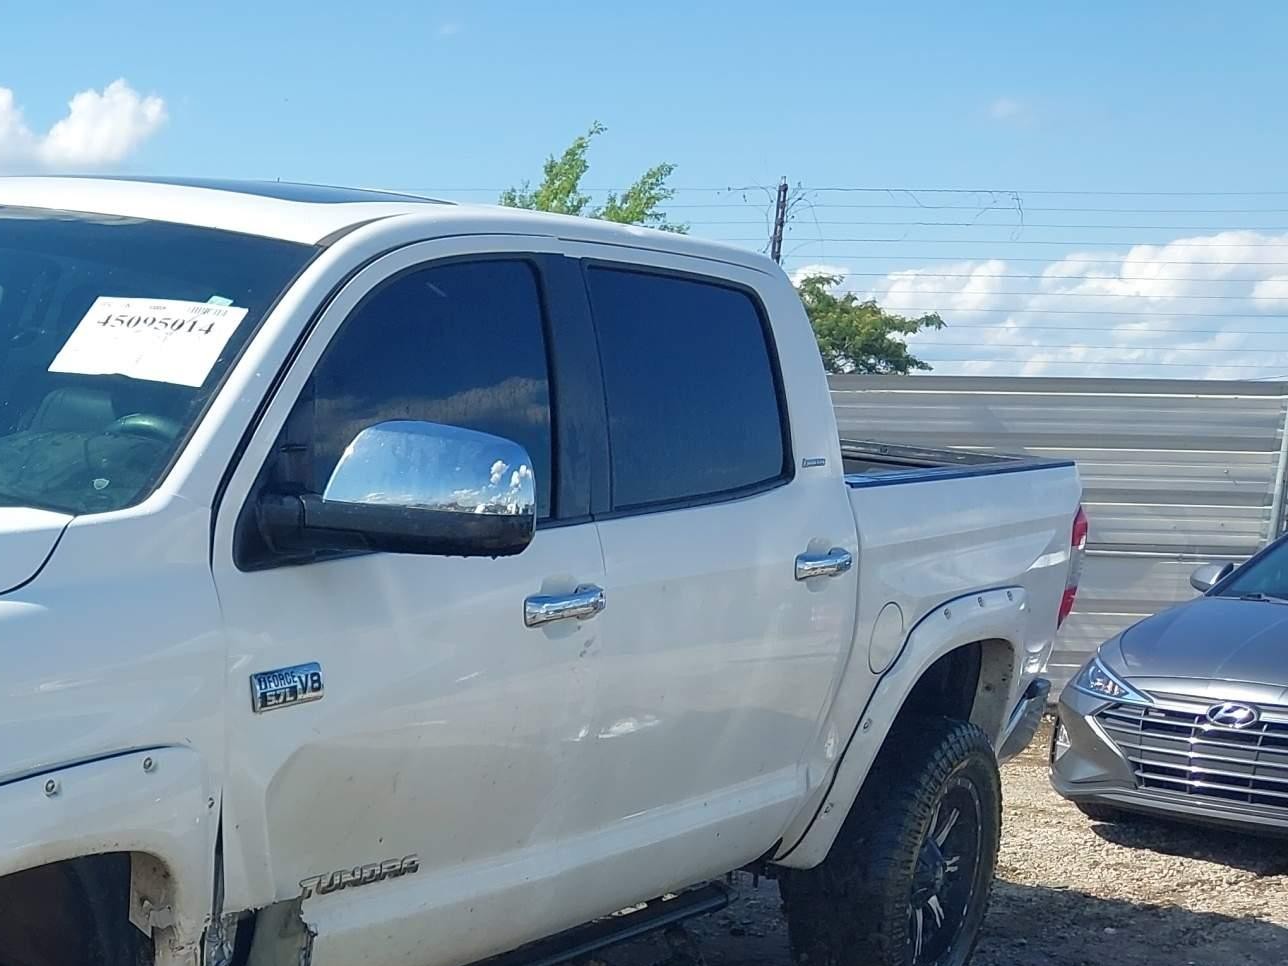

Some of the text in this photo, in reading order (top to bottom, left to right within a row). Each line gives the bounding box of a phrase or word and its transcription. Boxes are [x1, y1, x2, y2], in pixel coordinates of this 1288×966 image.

[96, 313, 216, 335] 45095014
[298, 671, 322, 694] V8
[265, 687, 295, 706] 5.7L
[298, 853, 419, 899] TUNDRA
